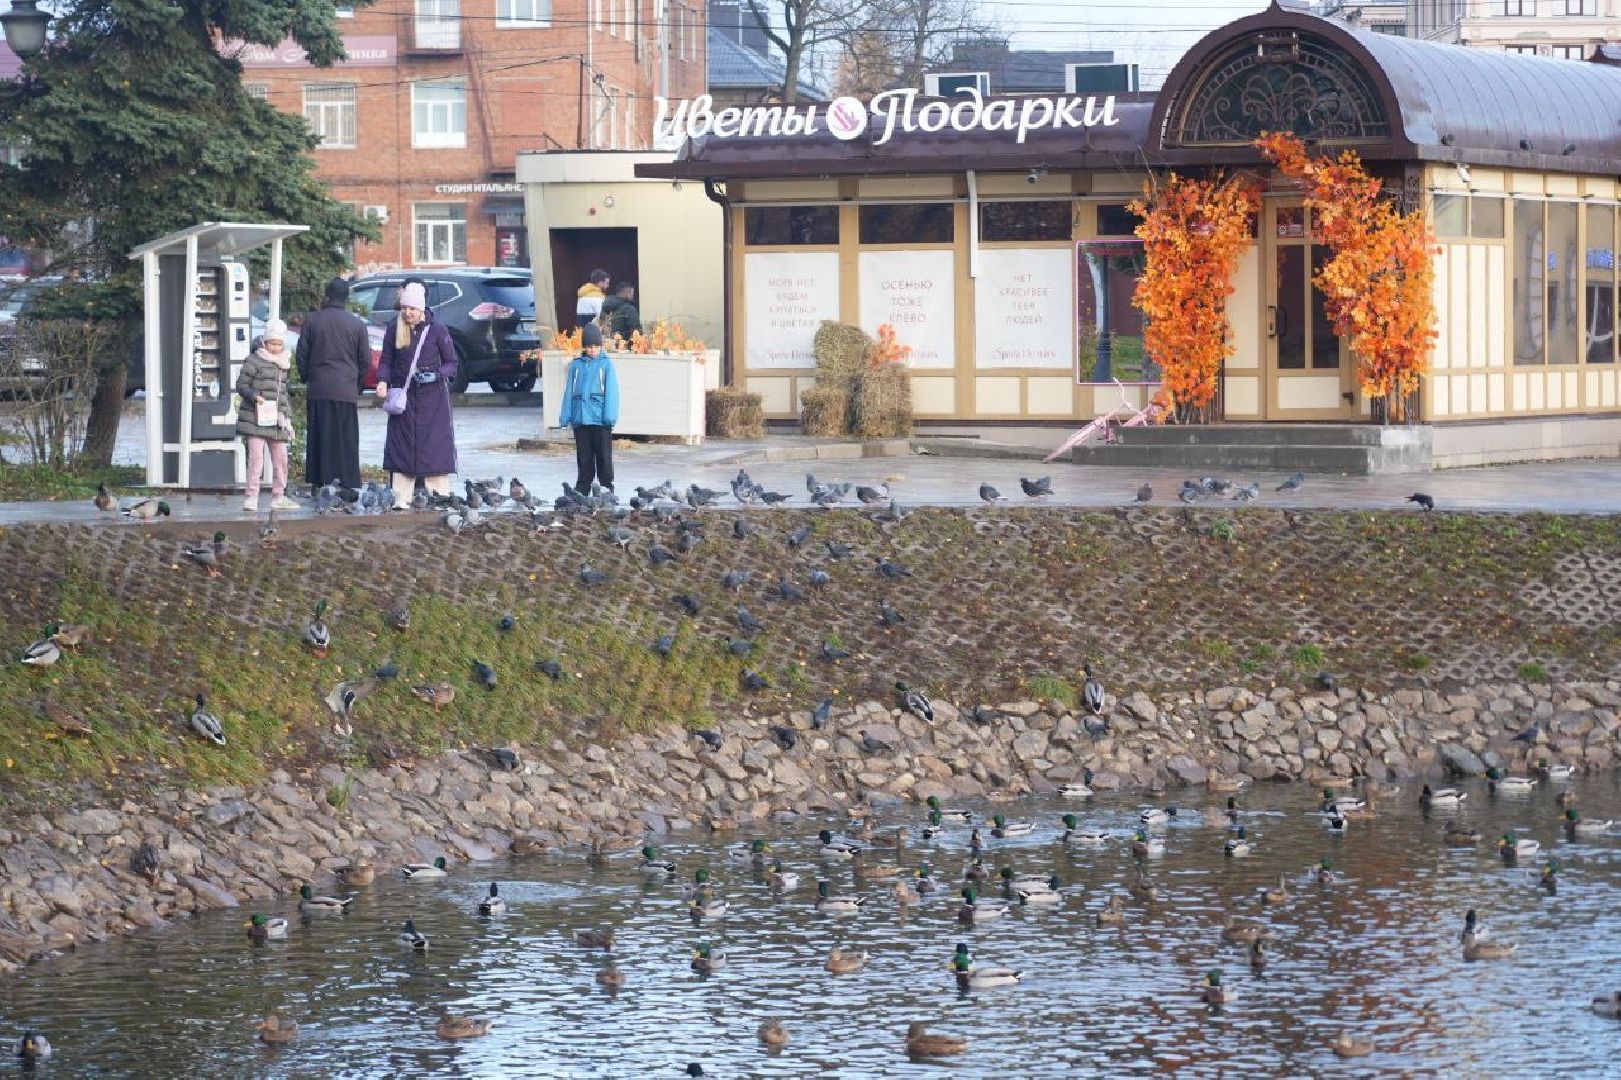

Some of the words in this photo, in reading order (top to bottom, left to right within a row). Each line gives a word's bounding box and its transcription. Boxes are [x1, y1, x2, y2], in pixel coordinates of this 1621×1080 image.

[653, 93, 820, 147] Цветы
[871, 86, 1120, 146] Подарки
[435, 183, 473, 194] СТУДИЯ
[881, 280, 933, 290] ОСЕНЬЮ
[890, 296, 922, 307] ТОЖЕ
